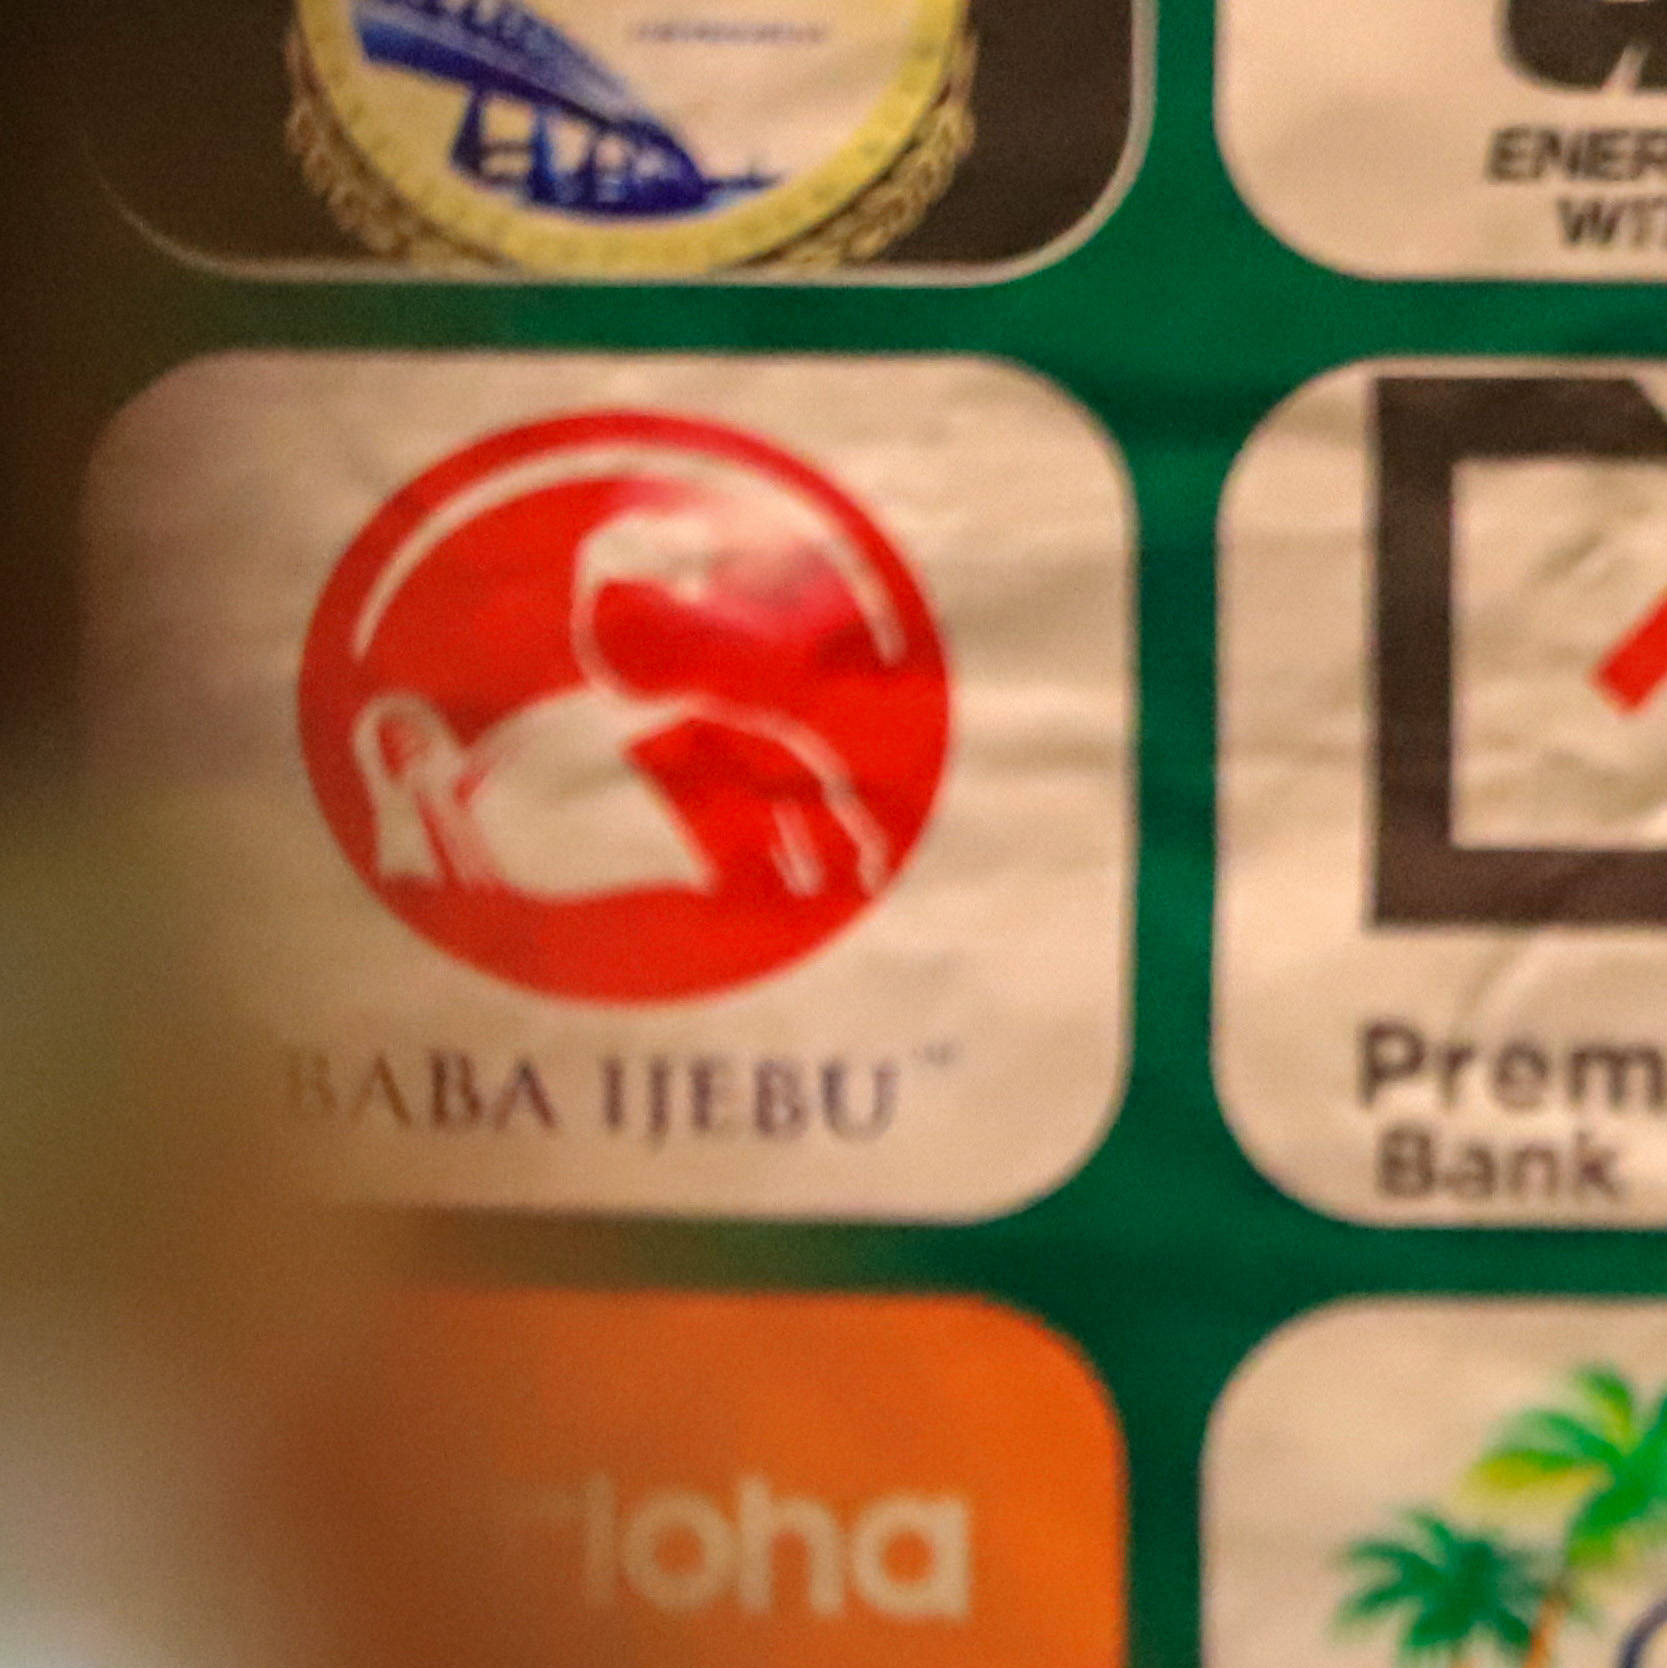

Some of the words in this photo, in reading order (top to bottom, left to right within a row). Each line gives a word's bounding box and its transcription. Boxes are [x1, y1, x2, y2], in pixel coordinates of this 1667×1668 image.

[288, 1050, 561, 1133] BABA
[598, 1050, 900, 1152] IJEBU
[1376, 1124, 1623, 1201] Bank
[530, 1468, 972, 1624] loha
